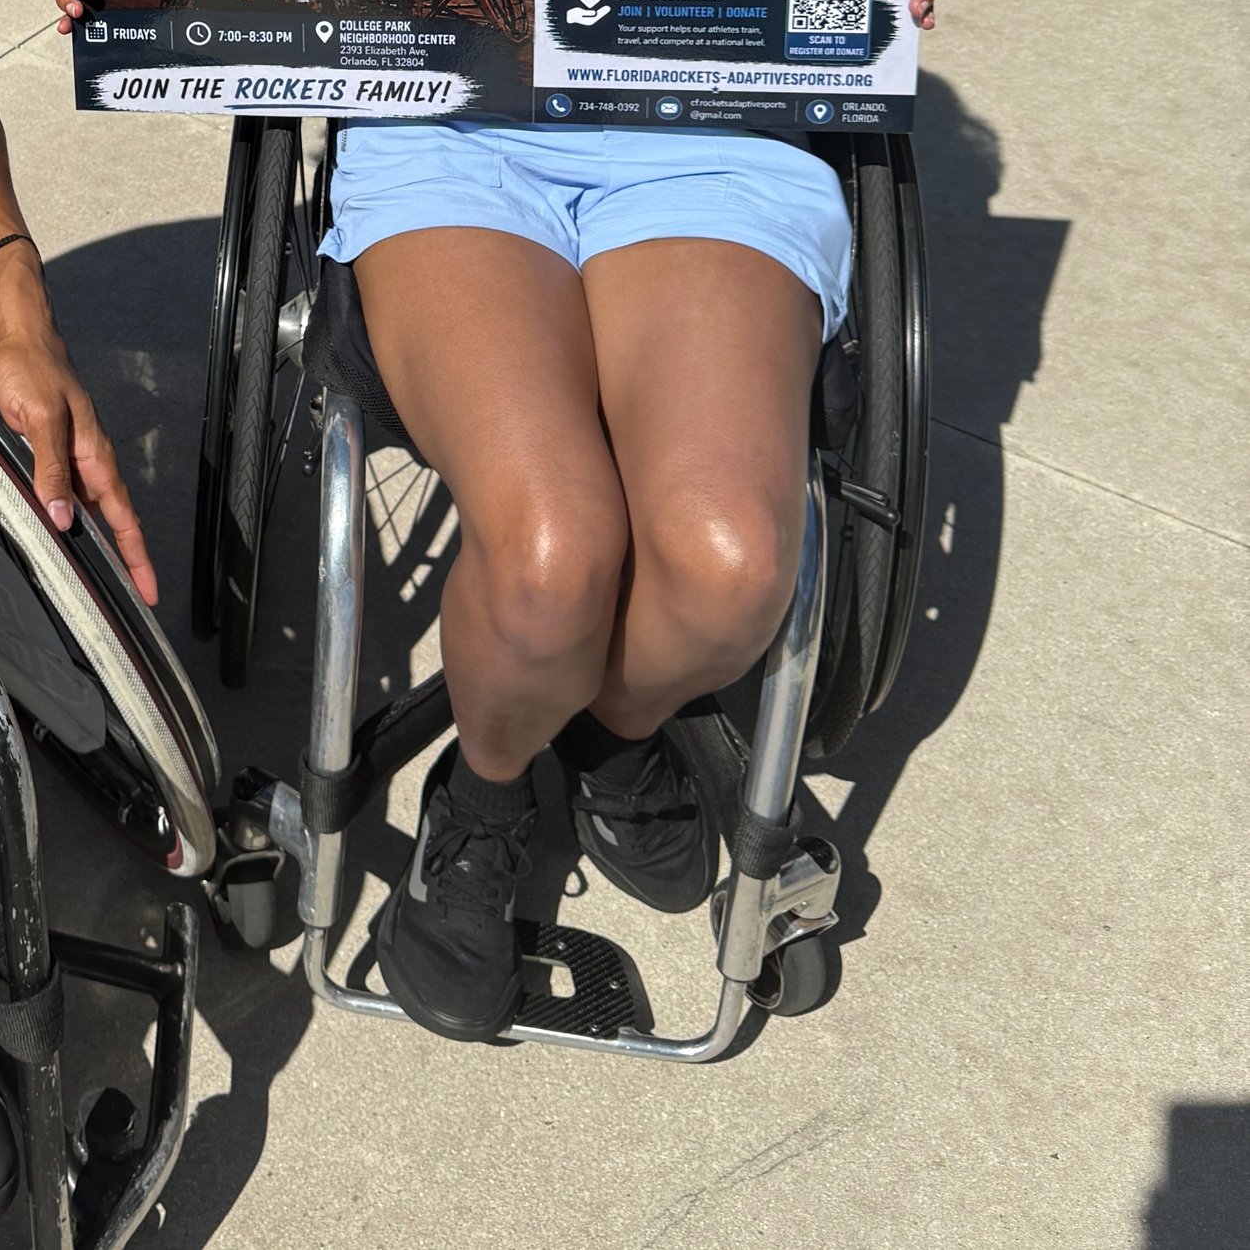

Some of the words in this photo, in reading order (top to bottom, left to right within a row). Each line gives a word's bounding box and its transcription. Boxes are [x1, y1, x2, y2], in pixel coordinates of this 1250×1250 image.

[617, 6, 642, 17] JOIN
[654, 6, 714, 18] VOLUNTEER
[726, 7, 768, 18] DONATE
[339, 20, 382, 32] COLLEGE
[384, 21, 411, 32] PARK
[617, 24, 636, 33] Your
[637, 25, 668, 35] support
[670, 24, 691, 35] helps
[708, 25, 740, 34] athletes
[741, 26, 762, 35] train,
[113, 28, 157, 40] FRIDAYS
[276, 31, 292, 43] PM
[339, 32, 415, 45] NEIGHBORHOOD
[418, 34, 456, 45] CENTER
[617, 37, 641, 46] travel,
[643, 37, 658, 45] and
[660, 38, 694, 47] compete
[695, 38, 704, 46] at
[711, 38, 744, 47] national
[745, 38, 766, 47] level.
[809, 35, 832, 45] SCAN
[834, 35, 846, 45] TO
[340, 45, 363, 55] 2393
[365, 45, 407, 56] Elizabeth
[409, 47, 429, 57] Ave,
[789, 47, 823, 55] REGISTER
[824, 47, 835, 55] OR
[835, 47, 864, 56] DONATE
[340, 57, 380, 67] Orlando,
[381, 57, 392, 66] FL
[395, 57, 424, 67] 32804
[567, 68, 873, 87] WWW.FLORIDAROCKETS-ADAPTIVESPORTS.ORG
[113, 78, 170, 100] JOIN
[180, 78, 225, 99] THE
[235, 78, 346, 100] ROCKETS
[356, 80, 452, 104] FAMILY!
[578, 101, 640, 112] 734-748-0392
[690, 110, 742, 120] @gmail.com
[841, 114, 879, 123] FLORIDA
